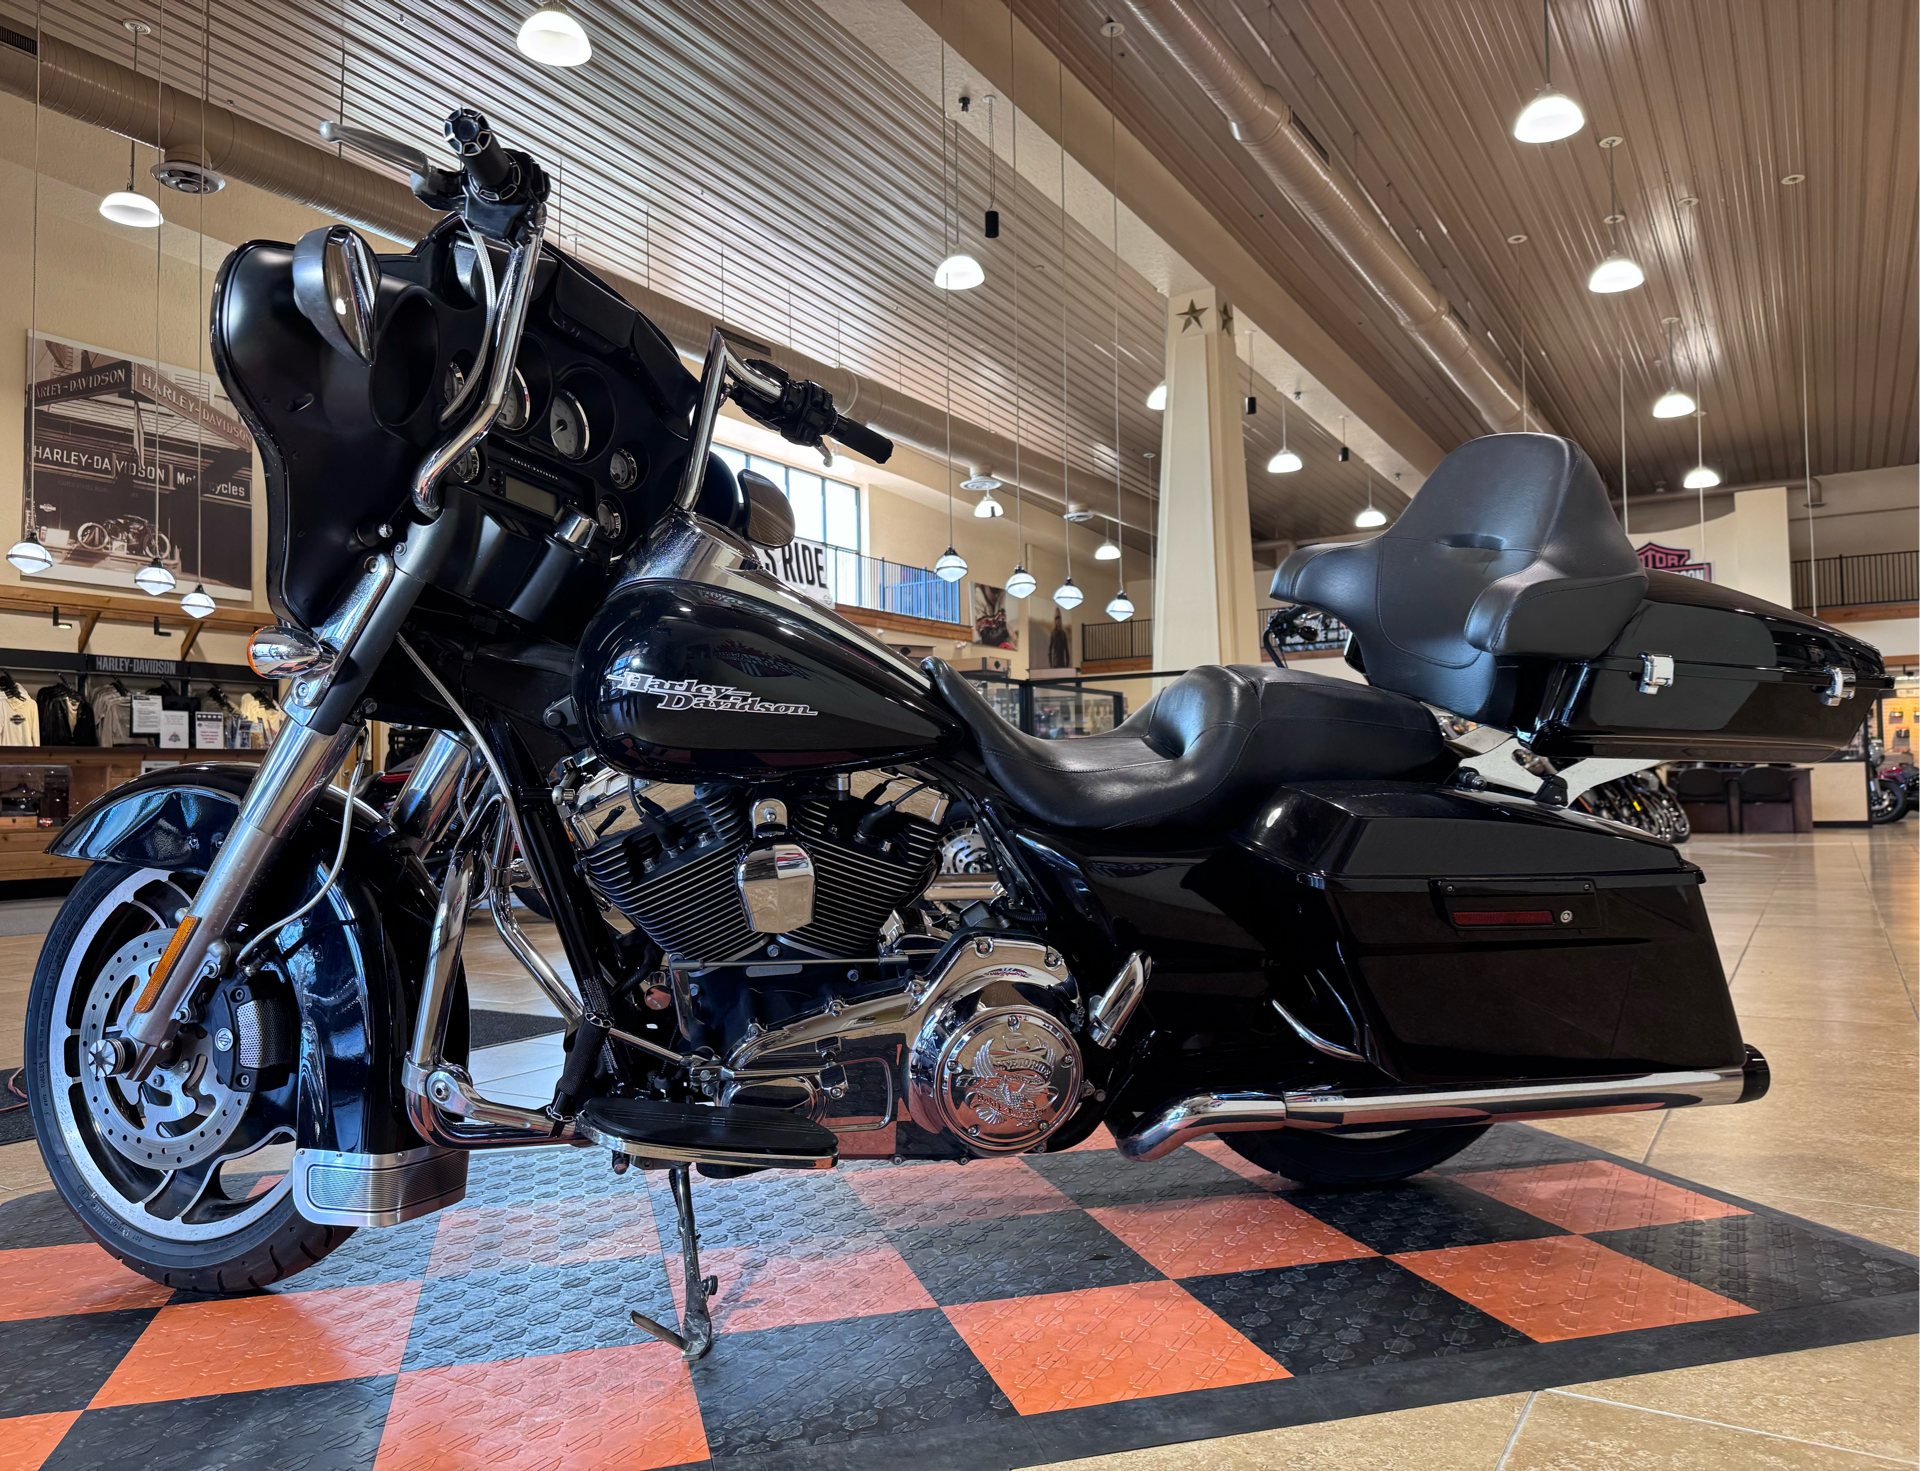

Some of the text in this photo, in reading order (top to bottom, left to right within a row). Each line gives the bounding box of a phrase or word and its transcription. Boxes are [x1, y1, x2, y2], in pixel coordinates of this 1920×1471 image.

[31, 369, 125, 400] ARLEY-DAVIDSON
[142, 372, 251, 443] HARLEY-DAVIDSON
[34, 445, 165, 481] HARLEY-DAVIDSON
[177, 471, 245, 497] Motrcycles
[782, 541, 828, 589] RIDE
[96, 656, 177, 675] HARLEY-DAVIDSON
[607, 672, 752, 701] Harley
[657, 692, 819, 716] Davidson
